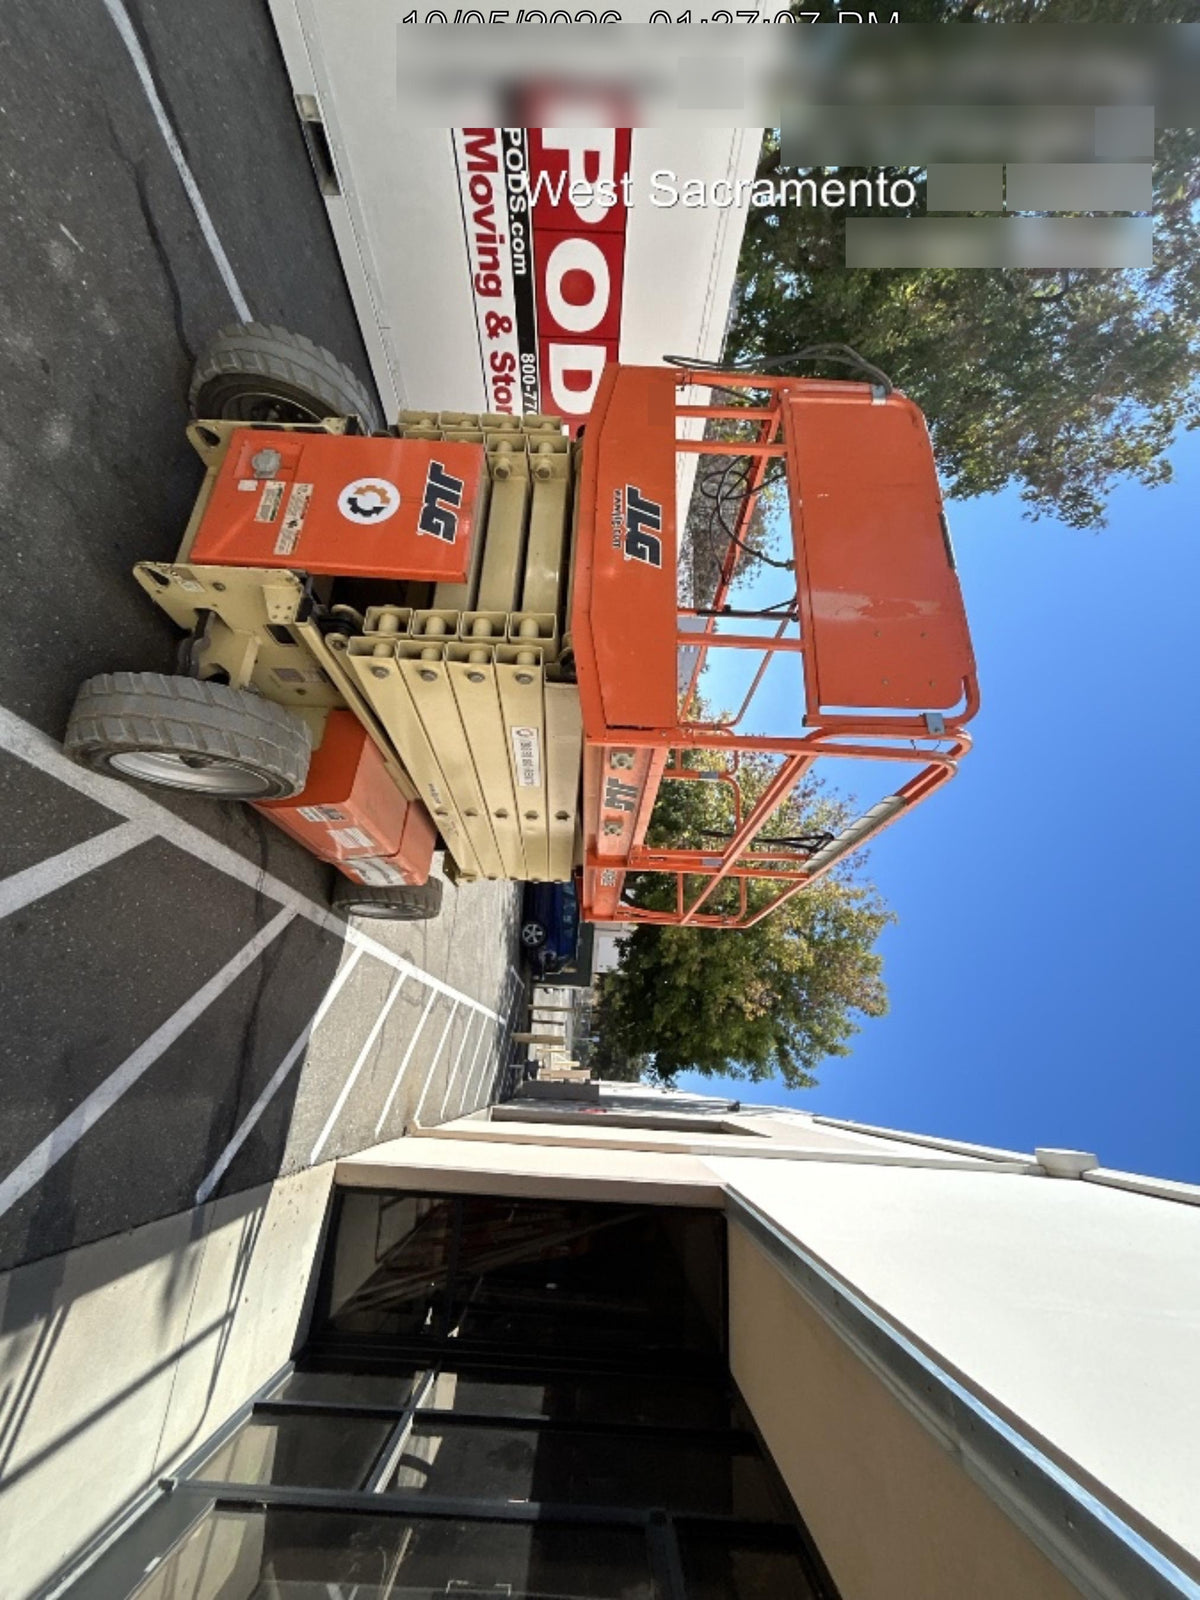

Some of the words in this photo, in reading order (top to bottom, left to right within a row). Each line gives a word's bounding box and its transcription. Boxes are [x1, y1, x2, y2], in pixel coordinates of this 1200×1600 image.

[462, 128, 506, 297] Moving
[484, 311, 512, 340] &
[541, 128, 616, 415] POD
[417, 460, 464, 544] JLG
[624, 484, 662, 569] JLG
[604, 776, 640, 813] JLG
